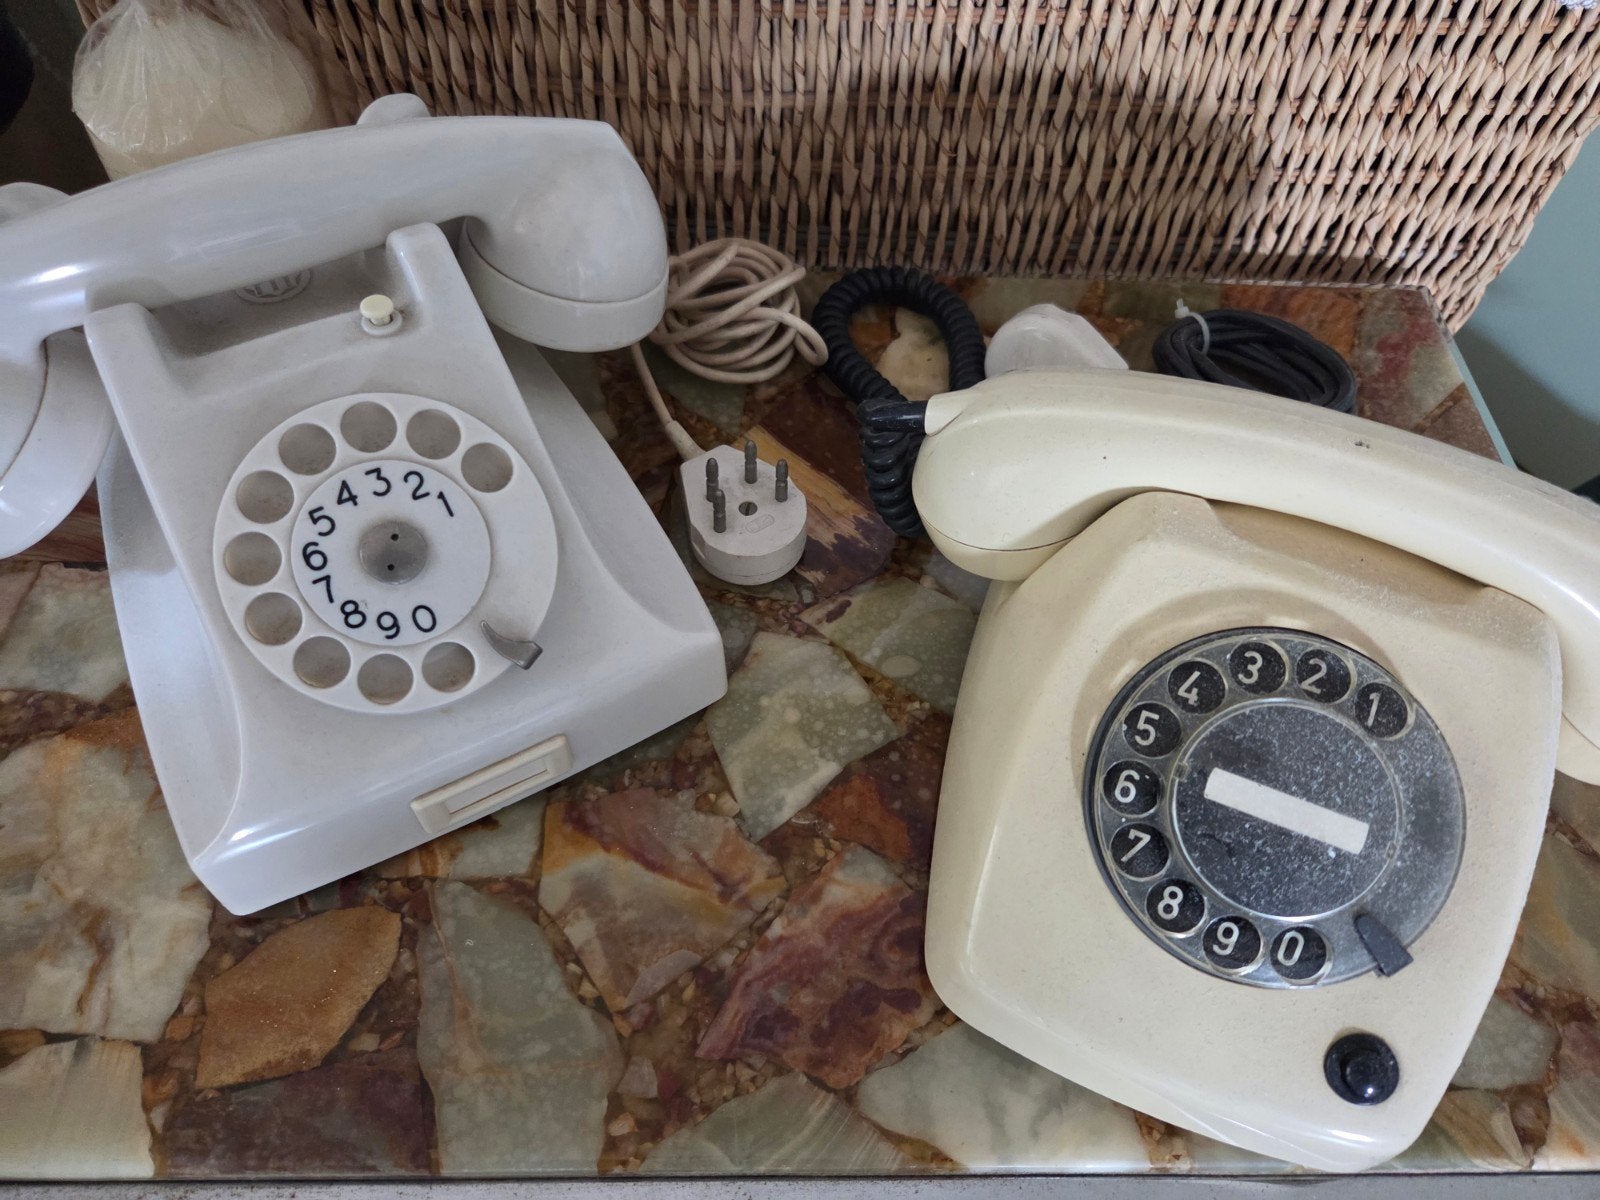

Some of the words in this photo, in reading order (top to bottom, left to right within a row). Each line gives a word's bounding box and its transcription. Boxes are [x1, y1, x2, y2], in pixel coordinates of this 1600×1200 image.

[337, 480, 358, 506] 4
[365, 468, 391, 496] 3
[404, 471, 430, 500] 2
[437, 491, 454, 517] 1
[308, 506, 335, 536] 5
[302, 542, 328, 571] 6
[312, 575, 334, 603] 7
[340, 600, 366, 629] 8
[377, 611, 400, 639] 9
[412, 605, 436, 633] 0
[1238, 651, 1262, 684] 3
[1300, 658, 1327, 694] 2
[1178, 671, 1200, 706] 4
[1365, 692, 1381, 728] 1
[1135, 710, 1159, 745] 5
[1115, 770, 1139, 803] 6
[1121, 829, 1151, 862] 7
[1158, 886, 1183, 919] 8
[1213, 922, 1239, 955] 9
[1277, 930, 1304, 966] 0
